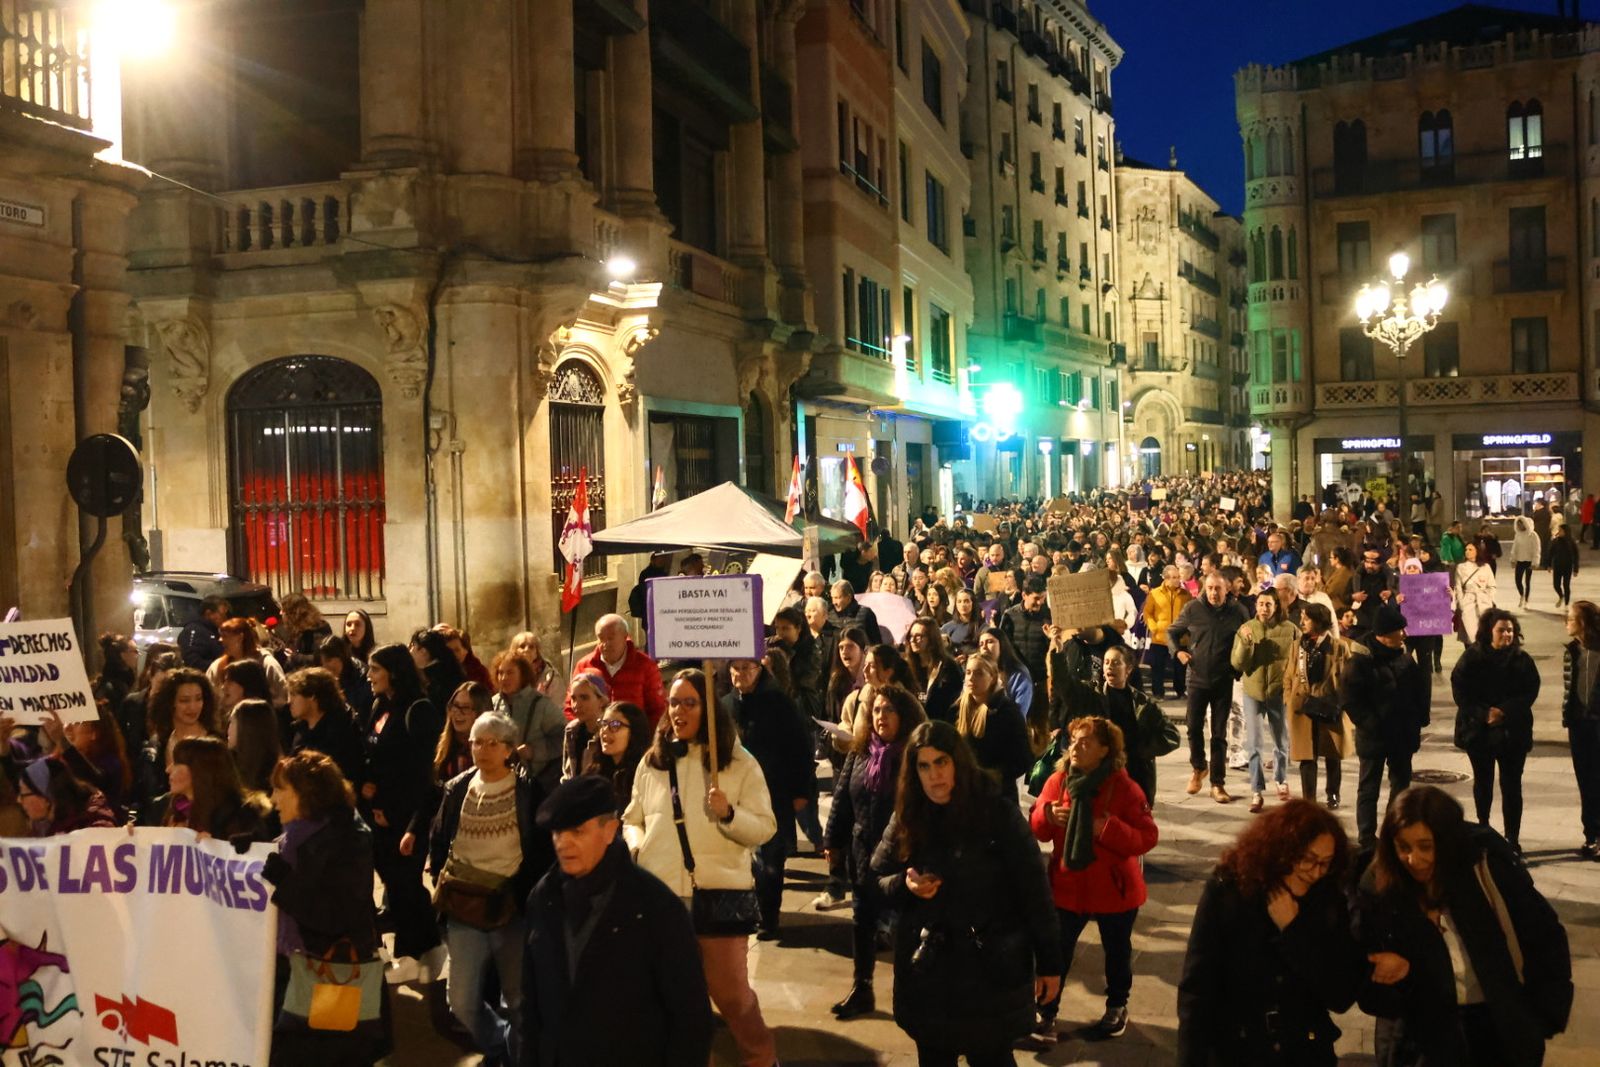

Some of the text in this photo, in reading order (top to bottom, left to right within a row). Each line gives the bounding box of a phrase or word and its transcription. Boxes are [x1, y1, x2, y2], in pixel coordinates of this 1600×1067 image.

[1341, 438, 1401, 449] SPRINGFIEL
[1482, 434, 1552, 445] SPRINGFIELD
[678, 589, 728, 599] ¡BASTA YA!
[669, 641, 683, 649] ¡NO
[701, 639, 741, 648] CALLARÁN!
[0, 663, 60, 683] UALDAD
[19, 691, 87, 712] MACHISMO
[9, 846, 49, 892] DE
[58, 843, 138, 894] LAS
